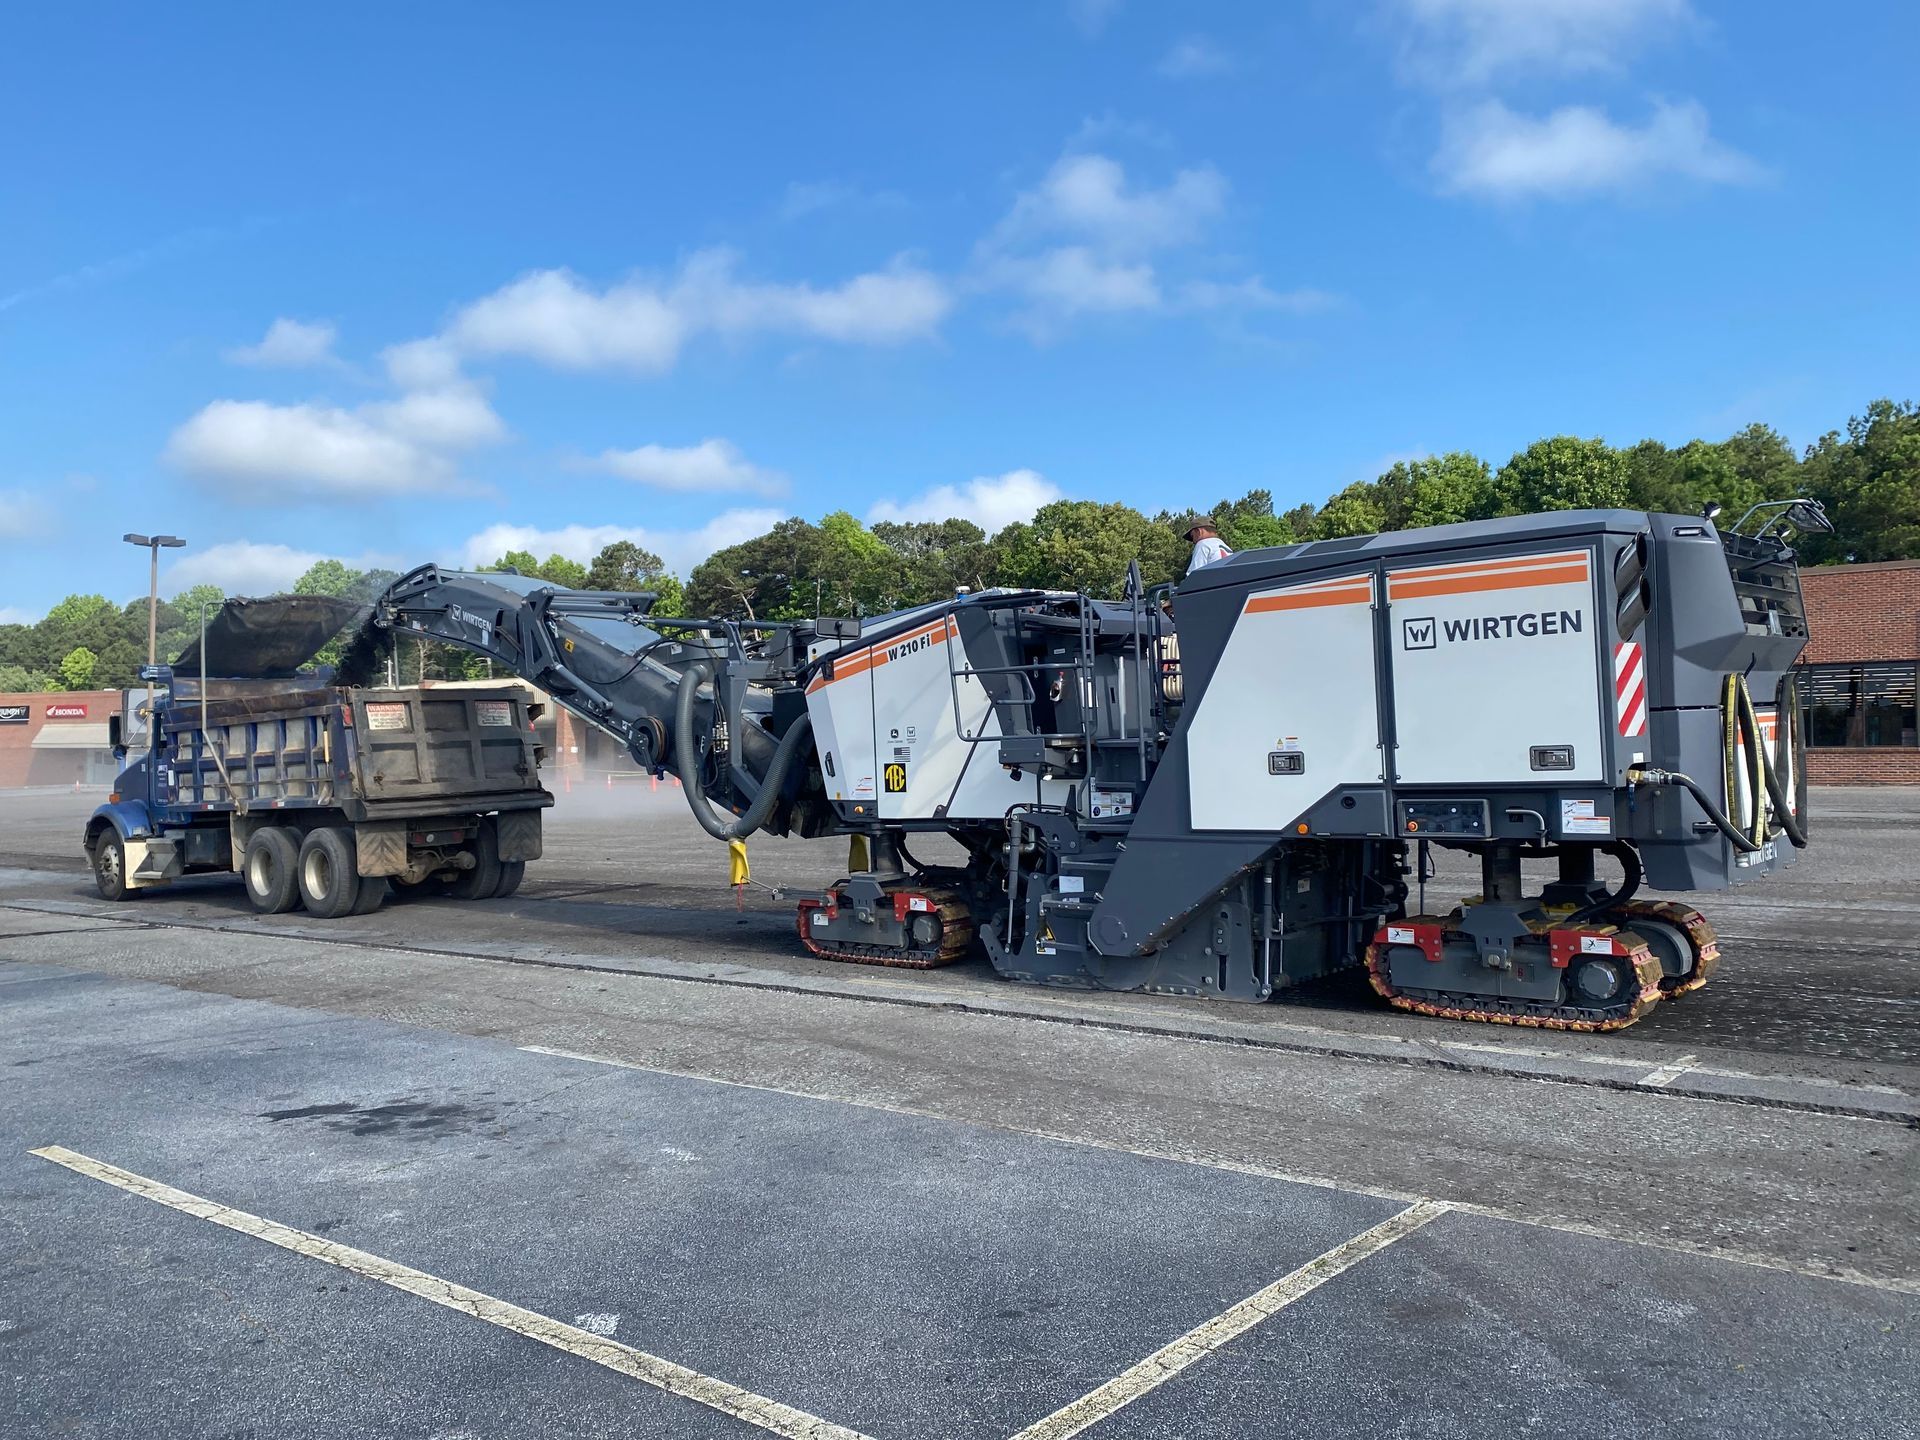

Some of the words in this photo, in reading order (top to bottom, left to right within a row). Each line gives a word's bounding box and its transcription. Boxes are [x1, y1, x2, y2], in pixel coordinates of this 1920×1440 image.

[462, 610, 492, 632] WIRTGEN
[1443, 609, 1583, 642] WIRTGEN
[888, 647, 898, 661] W
[900, 639, 919, 658] 210
[920, 633, 931, 650] Fi
[55, 708, 85, 716] HONDA
[369, 704, 403, 713] WARNING
[885, 764, 905, 791] TEC
